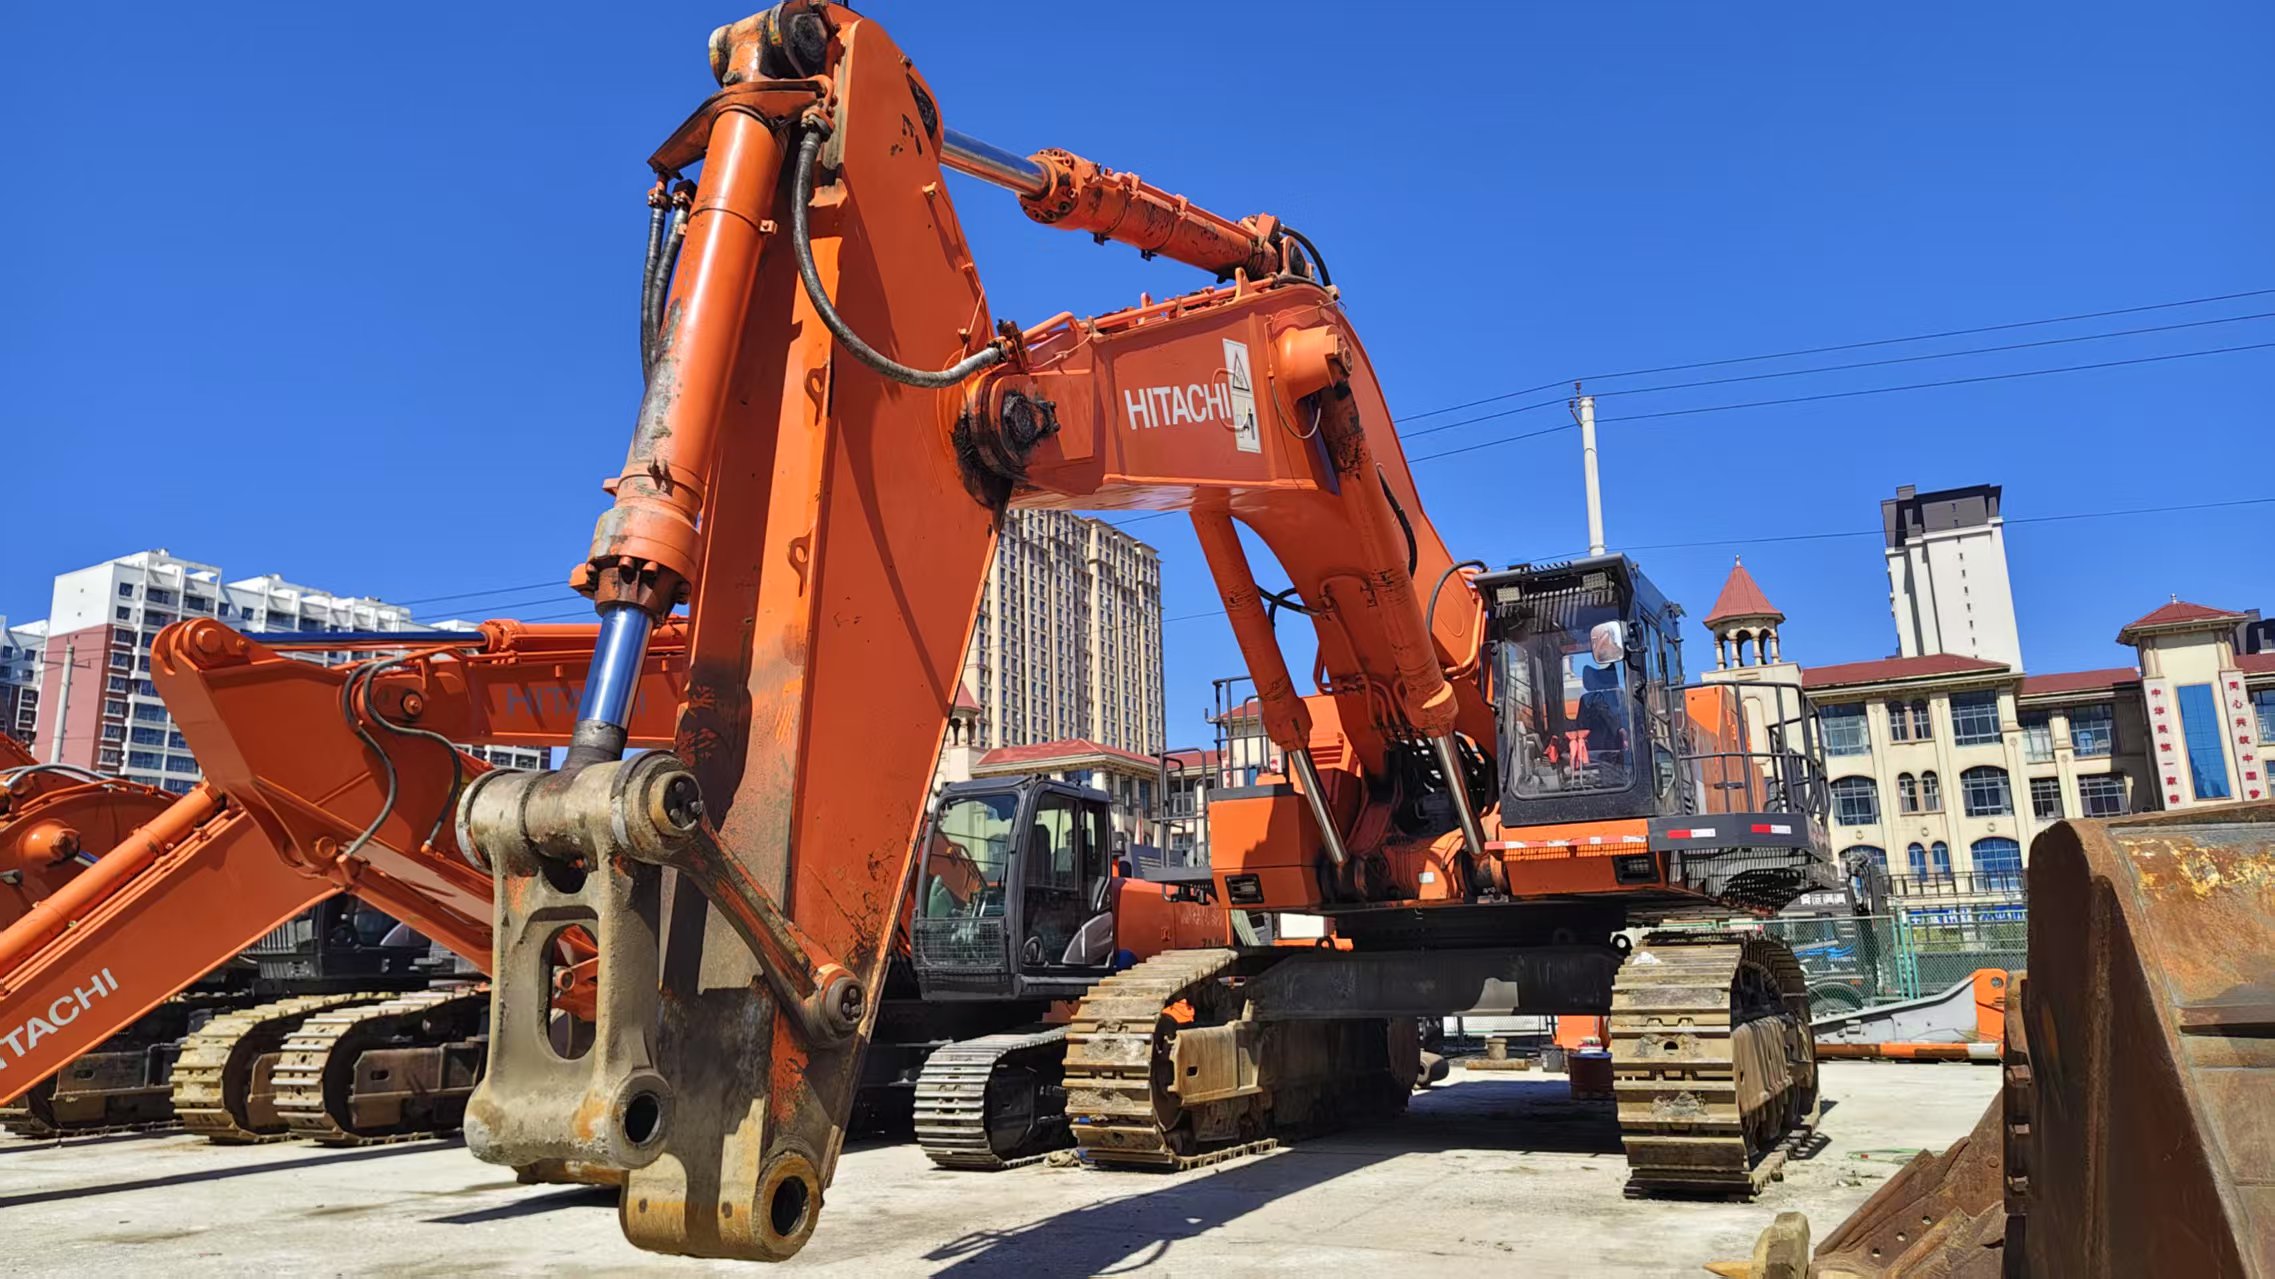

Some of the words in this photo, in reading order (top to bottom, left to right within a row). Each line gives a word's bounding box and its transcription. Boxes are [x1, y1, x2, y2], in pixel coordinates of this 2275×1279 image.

[1124, 383, 1232, 430] HITACHI
[506, 687, 646, 716] HITAI
[2228, 681, 2261, 800] 同心共筑中国梦
[2151, 687, 2180, 804] 中华民族一家亲
